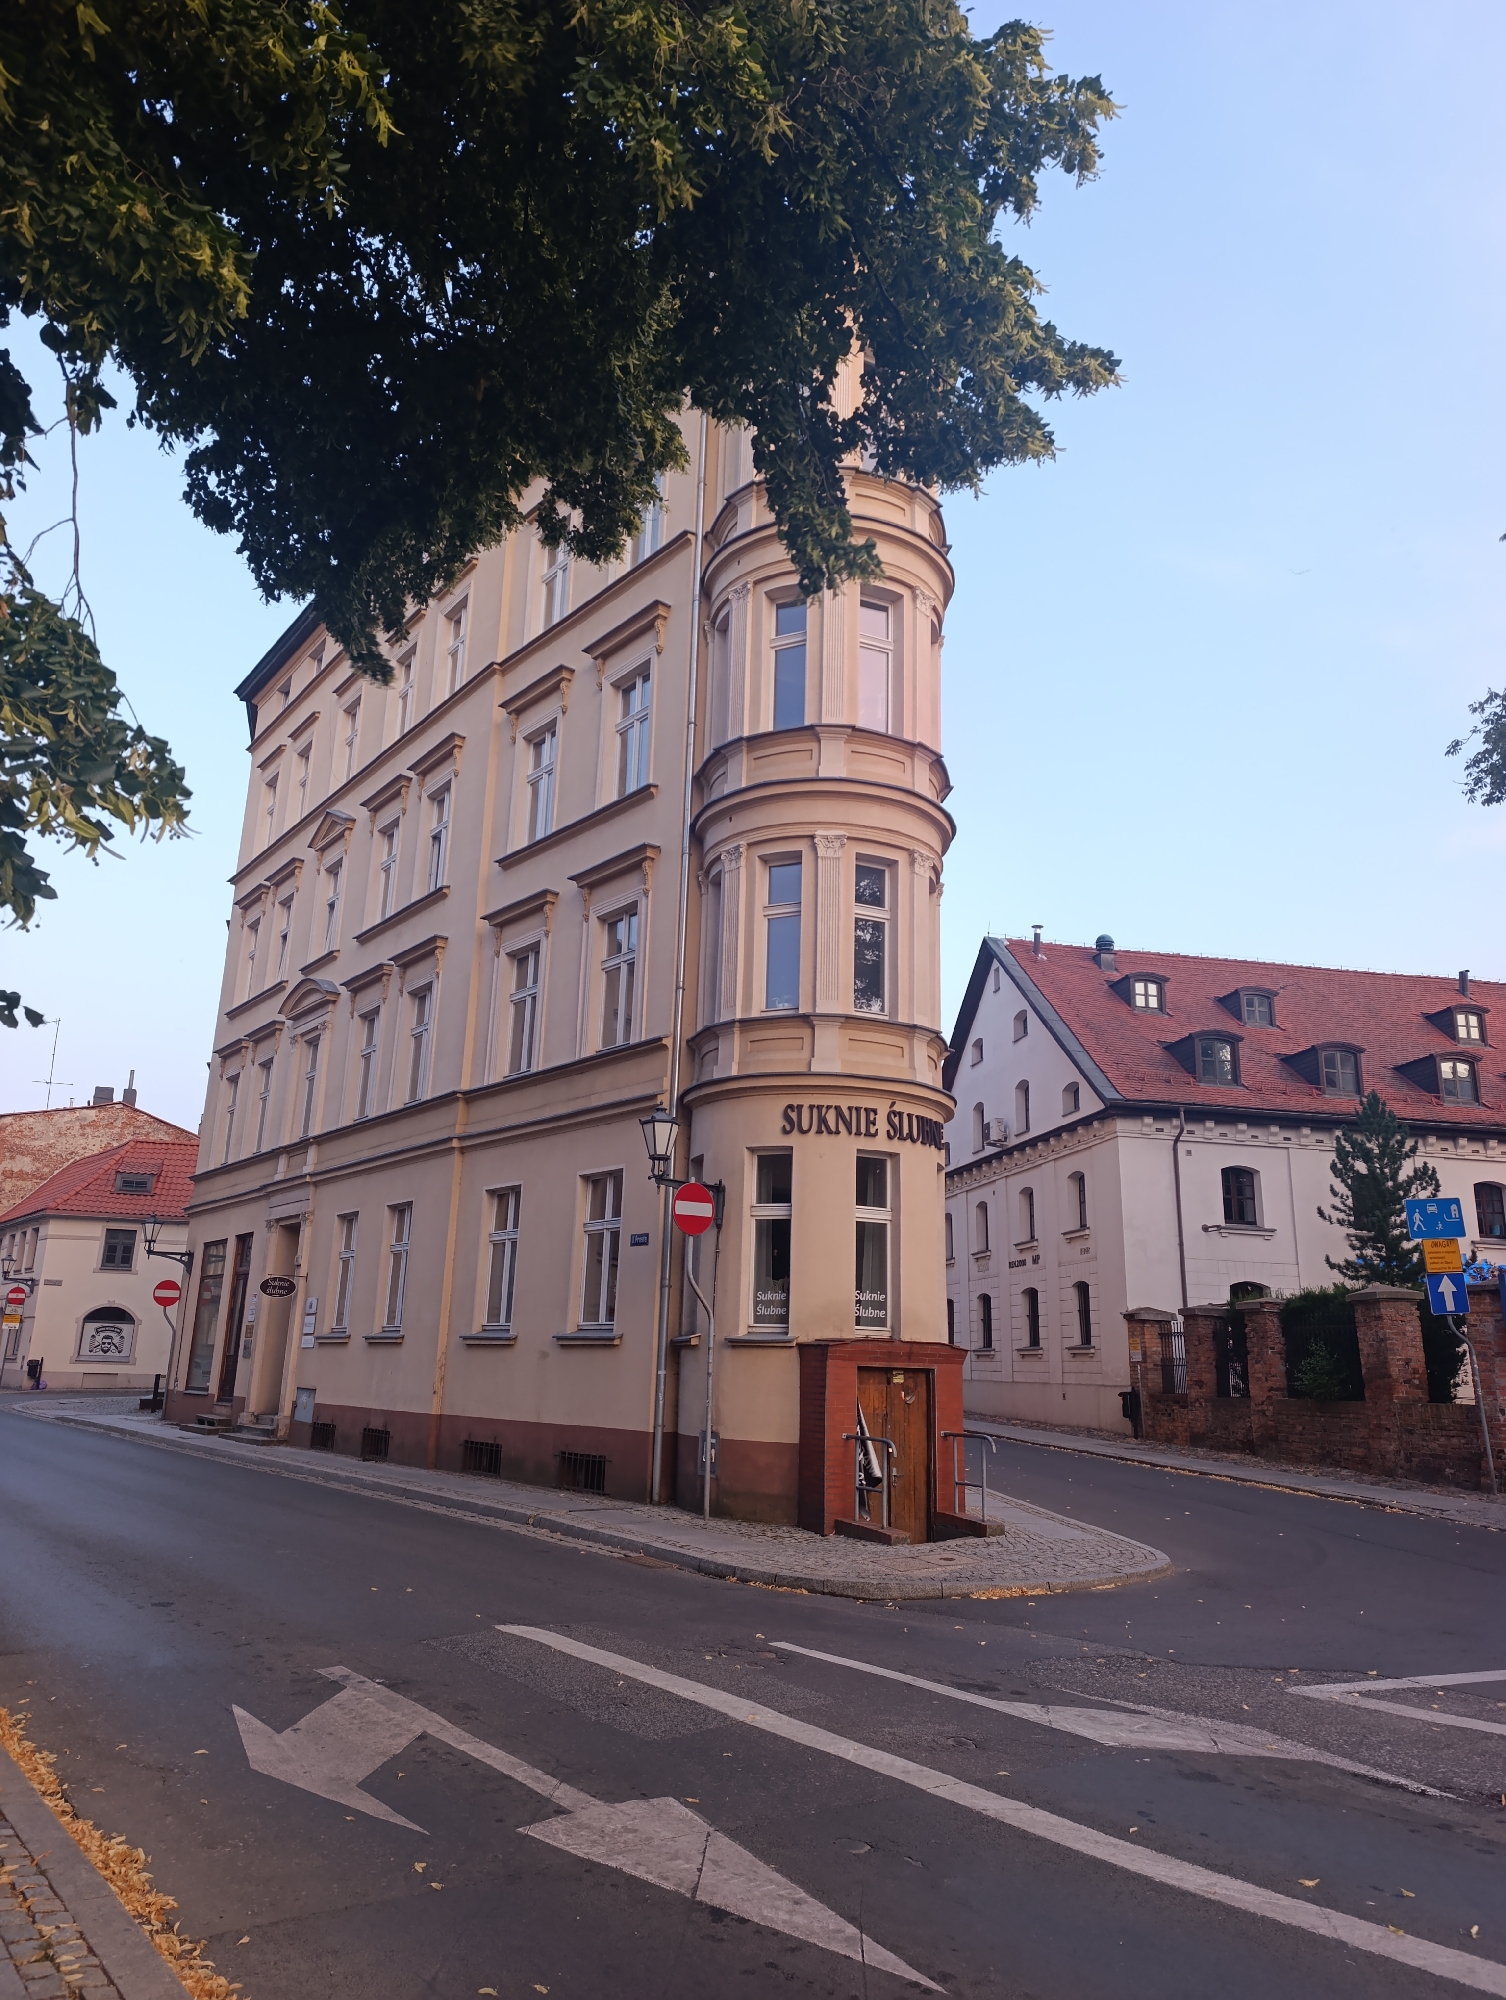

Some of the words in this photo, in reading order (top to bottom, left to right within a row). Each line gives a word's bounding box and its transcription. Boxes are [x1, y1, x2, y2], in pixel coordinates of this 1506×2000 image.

[782, 1103, 878, 1137] SUKNIE
[886, 1101, 944, 1150] ŚLUBNE
[756, 1291, 787, 1301] Suknie
[855, 1290, 886, 1302] Suknie
[756, 1304, 787, 1315] Ślubne
[854, 1304, 886, 1318] Ślubne
